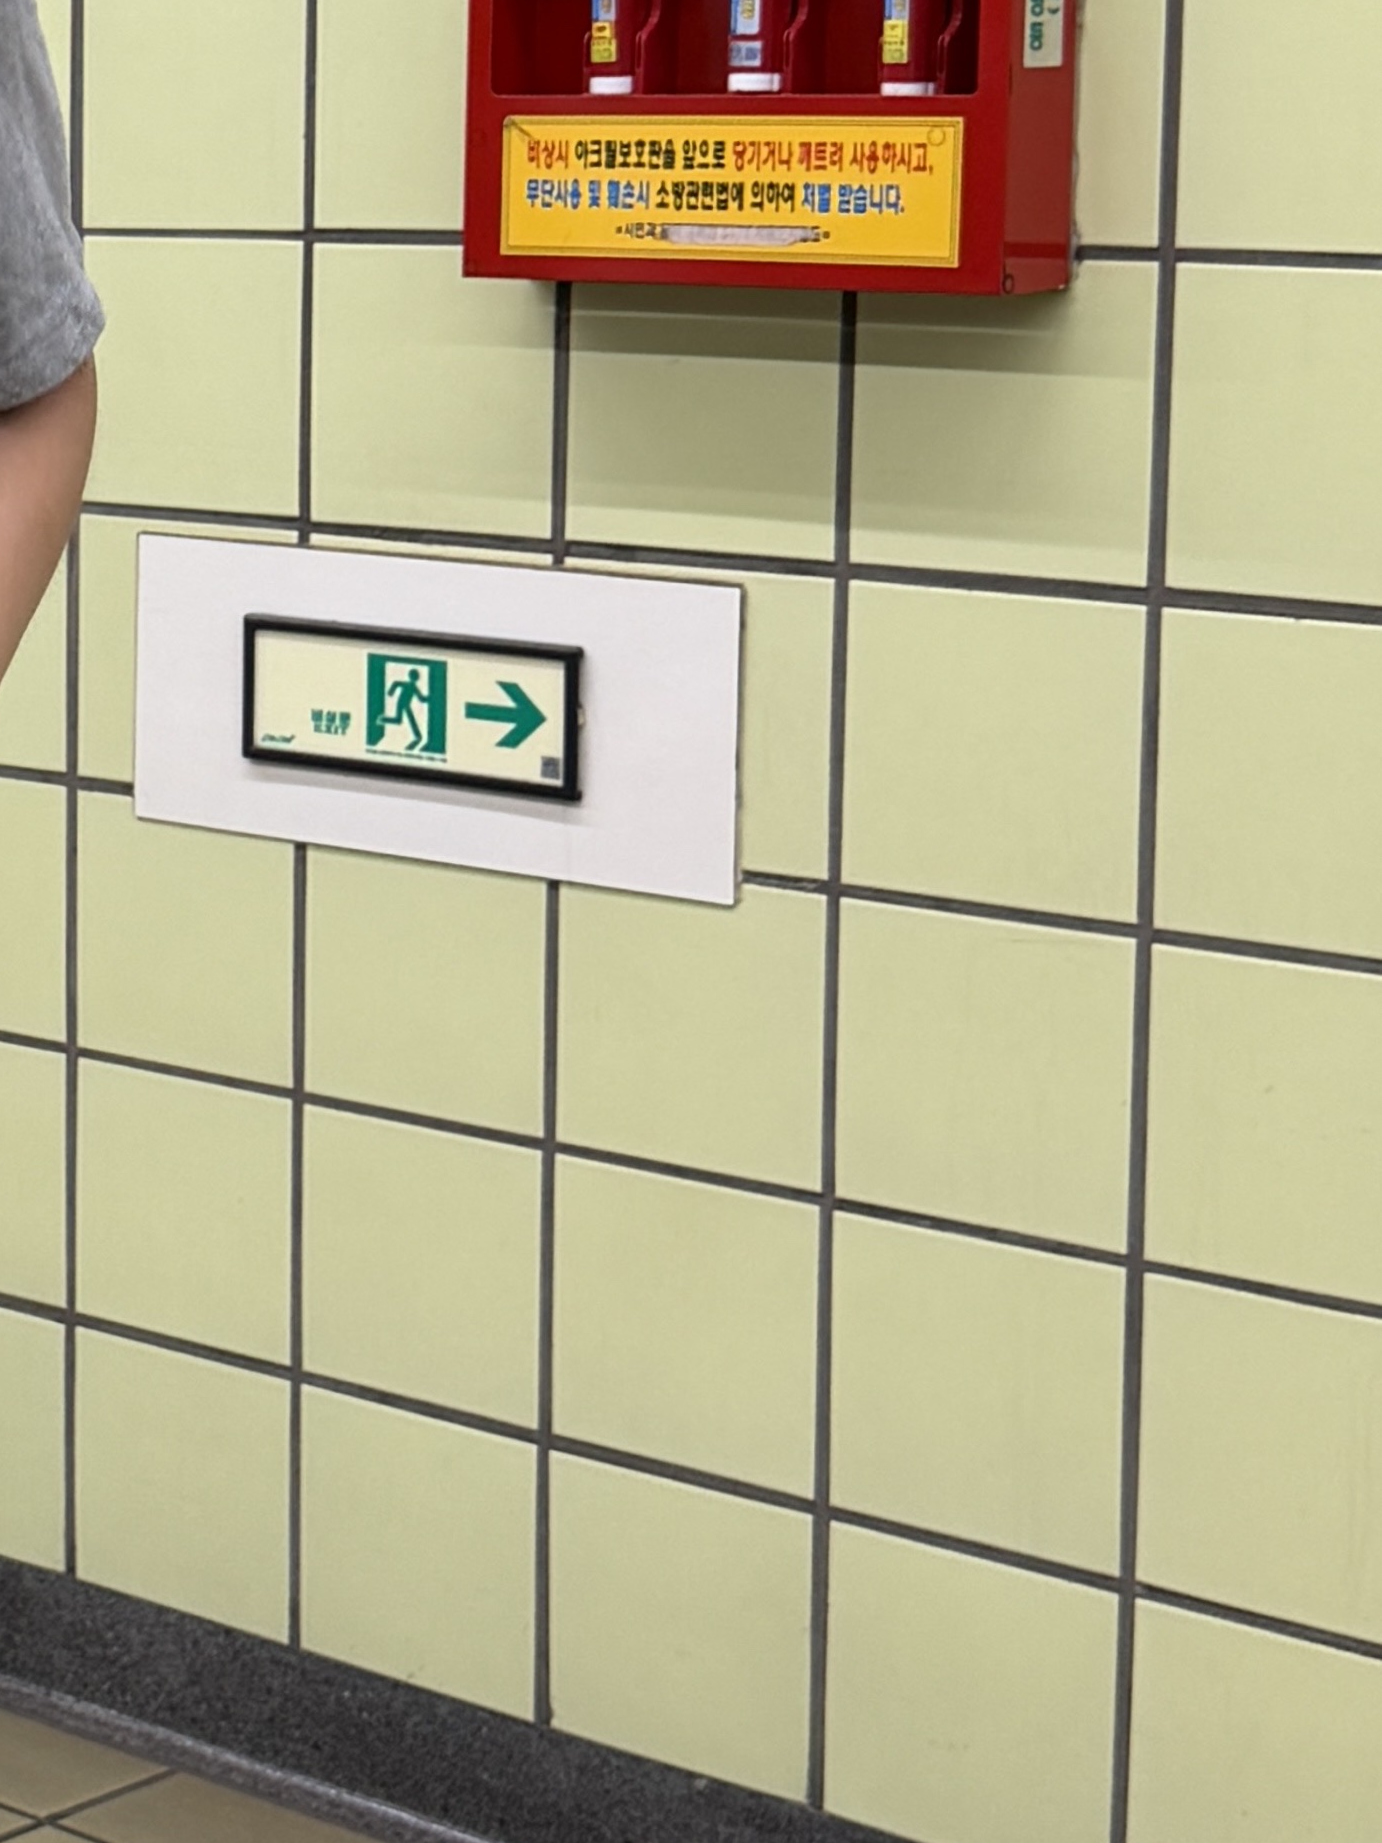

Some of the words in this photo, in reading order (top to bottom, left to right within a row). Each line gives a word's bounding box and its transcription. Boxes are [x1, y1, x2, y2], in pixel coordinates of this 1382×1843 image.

[527, 139, 570, 170] 비상시
[574, 138, 676, 170] 아크릴보호판을
[682, 138, 727, 170] 앞으로
[732, 140, 794, 173] 당기거나
[849, 140, 934, 175] 사용하시고,
[525, 177, 582, 210] 무단사용
[750, 180, 796, 212] 의하여
[800, 181, 833, 214] 처벌
[837, 182, 906, 215] 받습니다.
